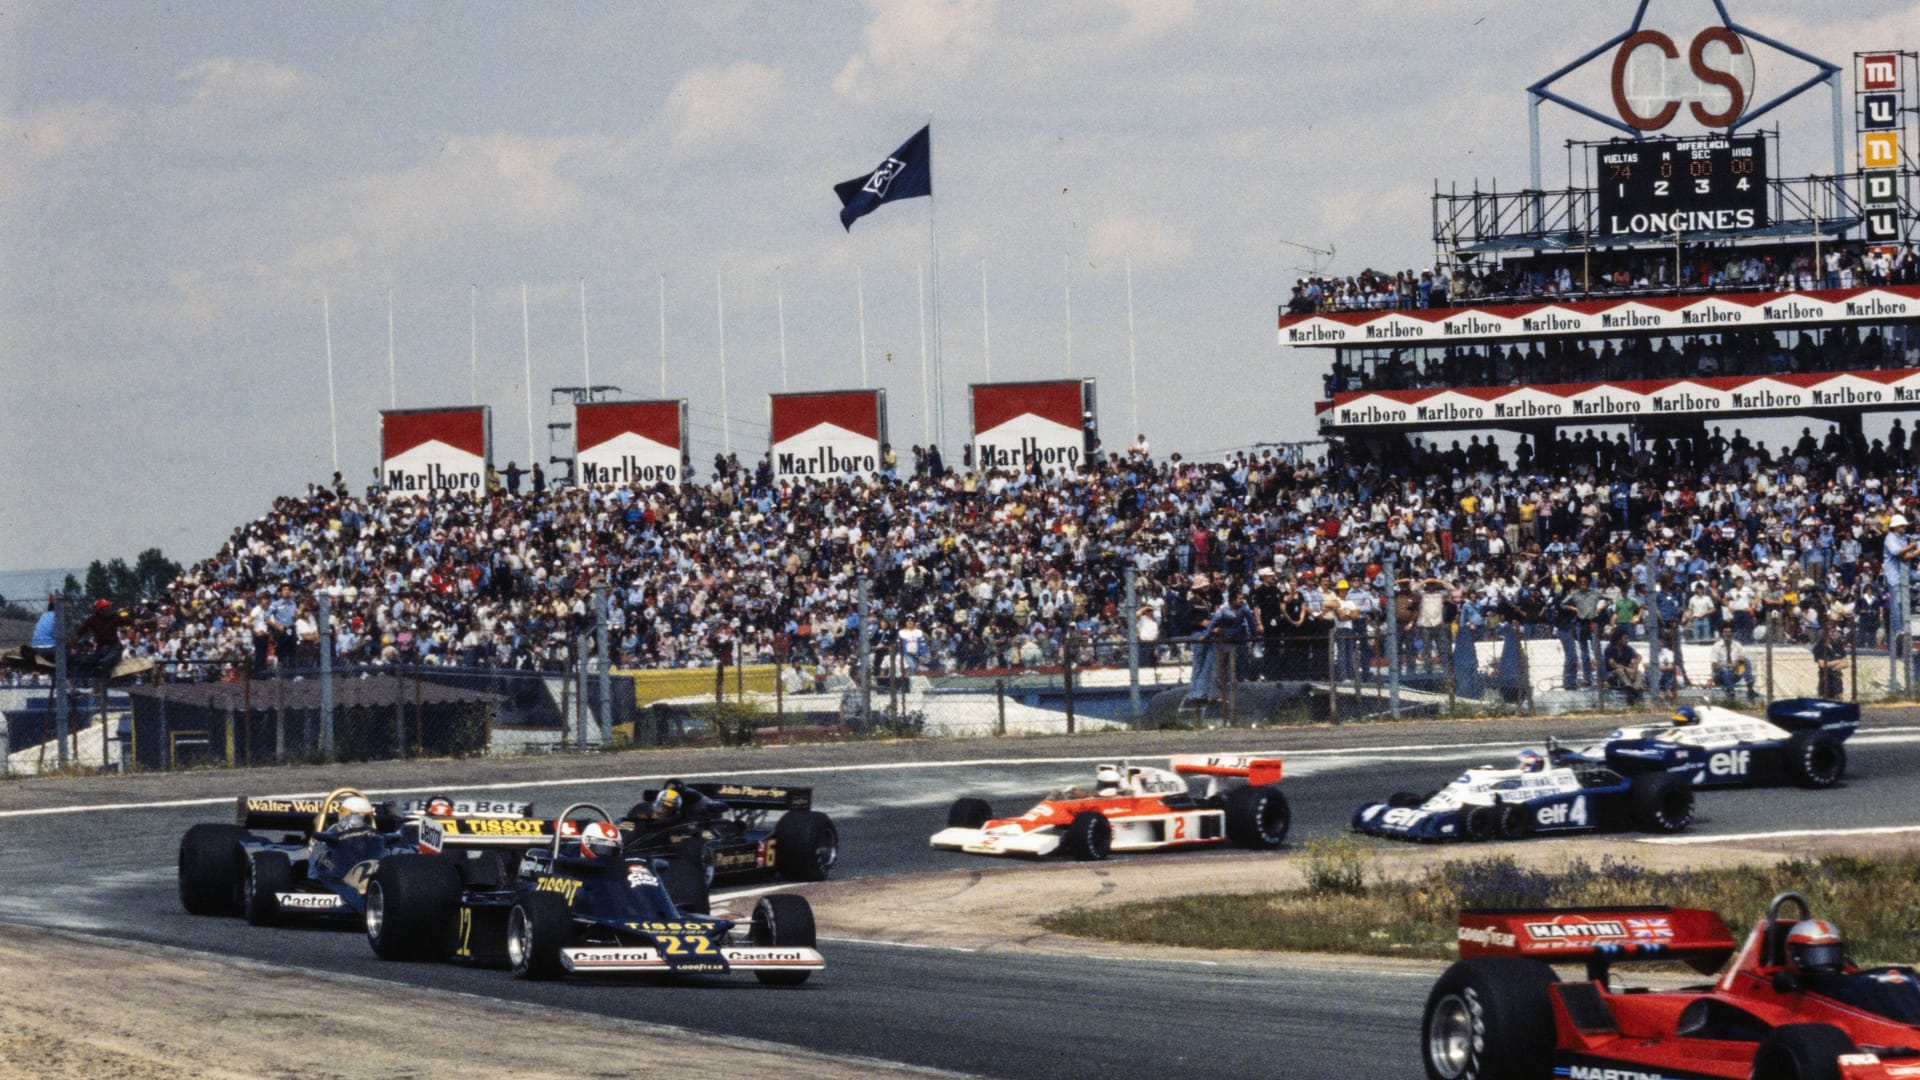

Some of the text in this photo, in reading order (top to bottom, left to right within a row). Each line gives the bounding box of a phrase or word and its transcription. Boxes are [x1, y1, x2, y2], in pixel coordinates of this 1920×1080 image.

[1611, 26, 1745, 131] CS
[1676, 140, 1730, 151] DIFERENCIA
[1603, 153, 1638, 164] VUELTAS
[1662, 151, 1671, 161] M
[1691, 150, 1711, 160] SEC
[1660, 162, 1672, 178] 0
[1689, 160, 1713, 177] 00
[1731, 158, 1754, 174] 00
[1618, 177, 1750, 198] 1 2 3 4
[1611, 208, 1755, 235] LONGINES
[1289, 299, 1907, 342] Marlboro Marlboro Marlboro Marlboro Marlboro Marlboro Marlboro Marlboro
[1341, 406, 1406, 424] Marlboro
[1417, 404, 1483, 421] Marlboro
[1495, 401, 1562, 418] Marlboro
[1573, 396, 1641, 415] Marlboro
[1652, 394, 1720, 412] Marlboro
[1732, 391, 1801, 408] Marlboro
[1812, 387, 1882, 405] Marlboro
[778, 446, 875, 476] Marlboro
[979, 436, 1080, 467] Marlboro
[388, 463, 481, 491] Marlboro
[582, 455, 677, 484] Marlboro
[1709, 750, 1751, 776] elf
[248, 800, 291, 813] Walter
[1536, 794, 1587, 826] elf 4
[465, 819, 545, 835] TISSOT
[1173, 816, 1186, 839] 2
[279, 894, 339, 907] Castrol
[624, 922, 716, 931] TISSOT
[1457, 926, 1516, 947] GOODYEAR
[1531, 923, 1621, 938] MARTINI
[656, 935, 718, 955] 22
[573, 951, 649, 961] Castrol
[728, 951, 802, 961] Castrol
[676, 963, 724, 972] GOODYEAR
